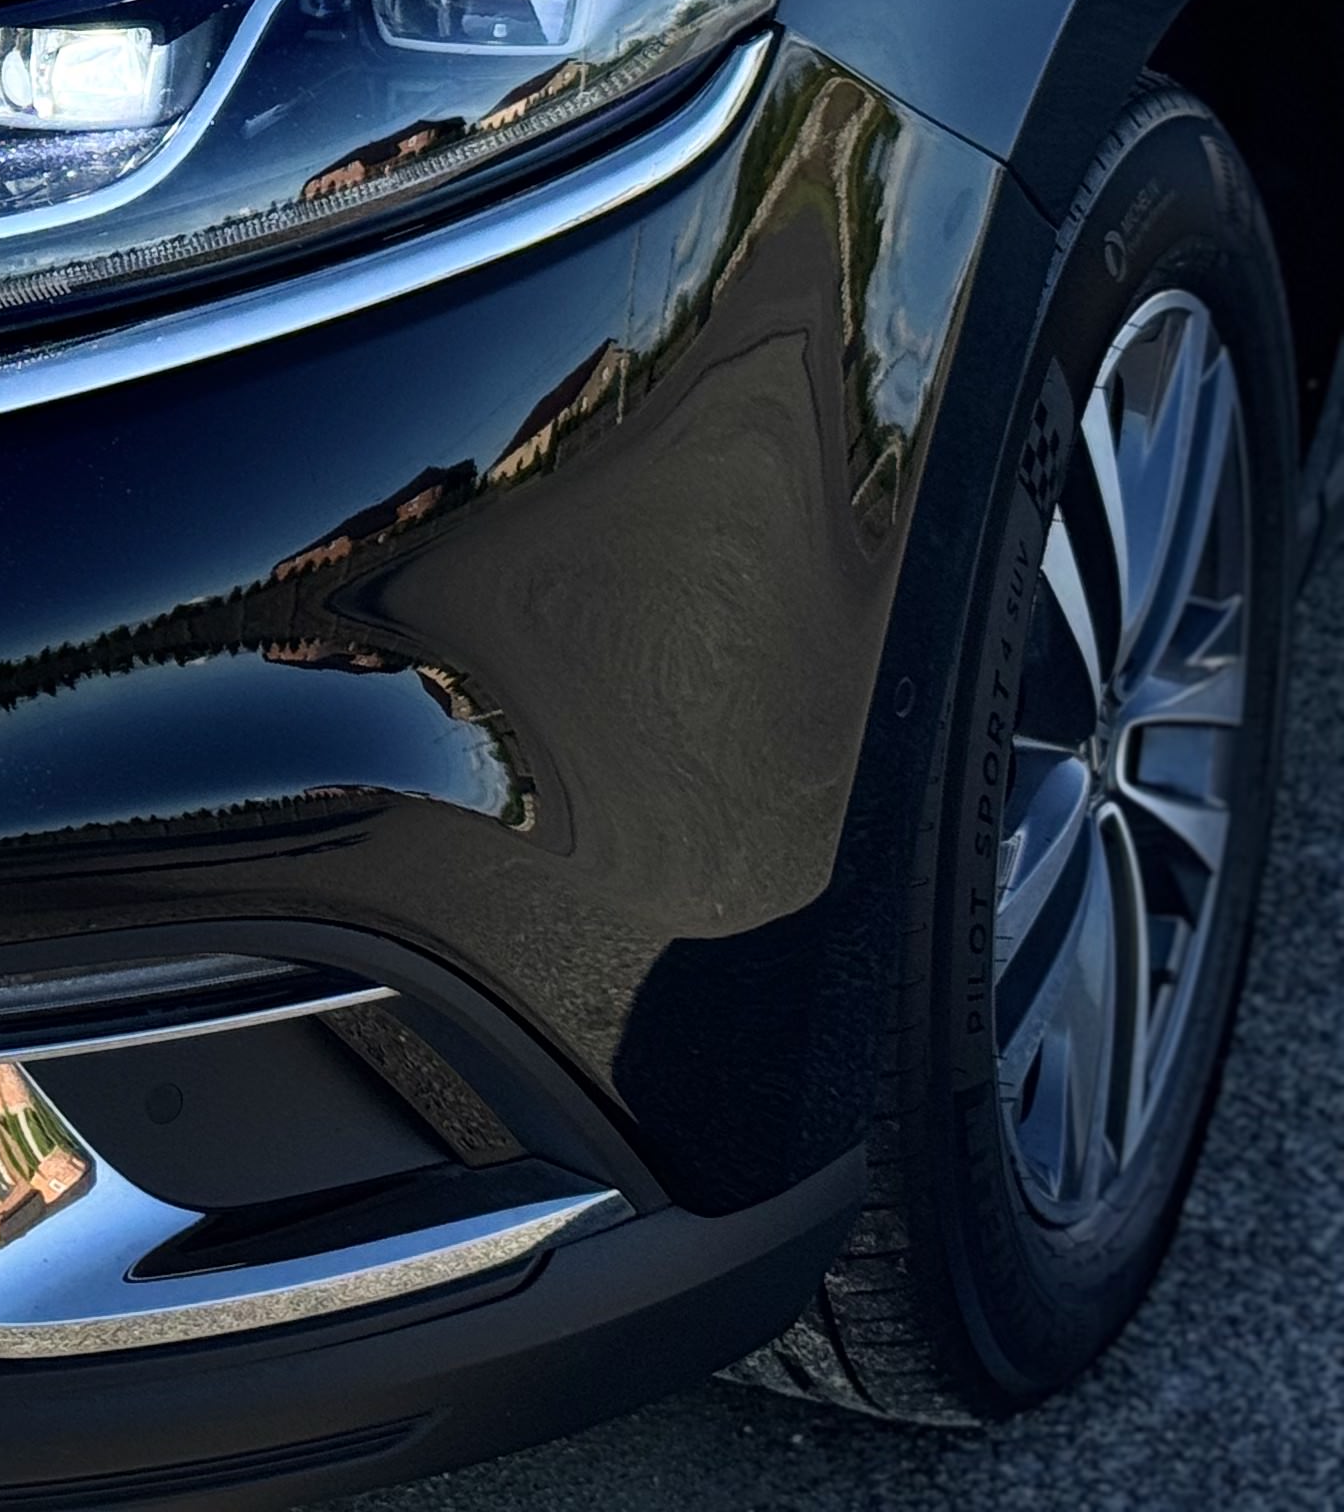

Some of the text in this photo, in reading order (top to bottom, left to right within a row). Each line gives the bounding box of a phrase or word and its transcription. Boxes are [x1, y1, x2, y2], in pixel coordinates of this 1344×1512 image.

[1006, 538, 1030, 622] SUV
[973, 668, 1010, 860] SPORT
[965, 887, 990, 1036] PILOT
